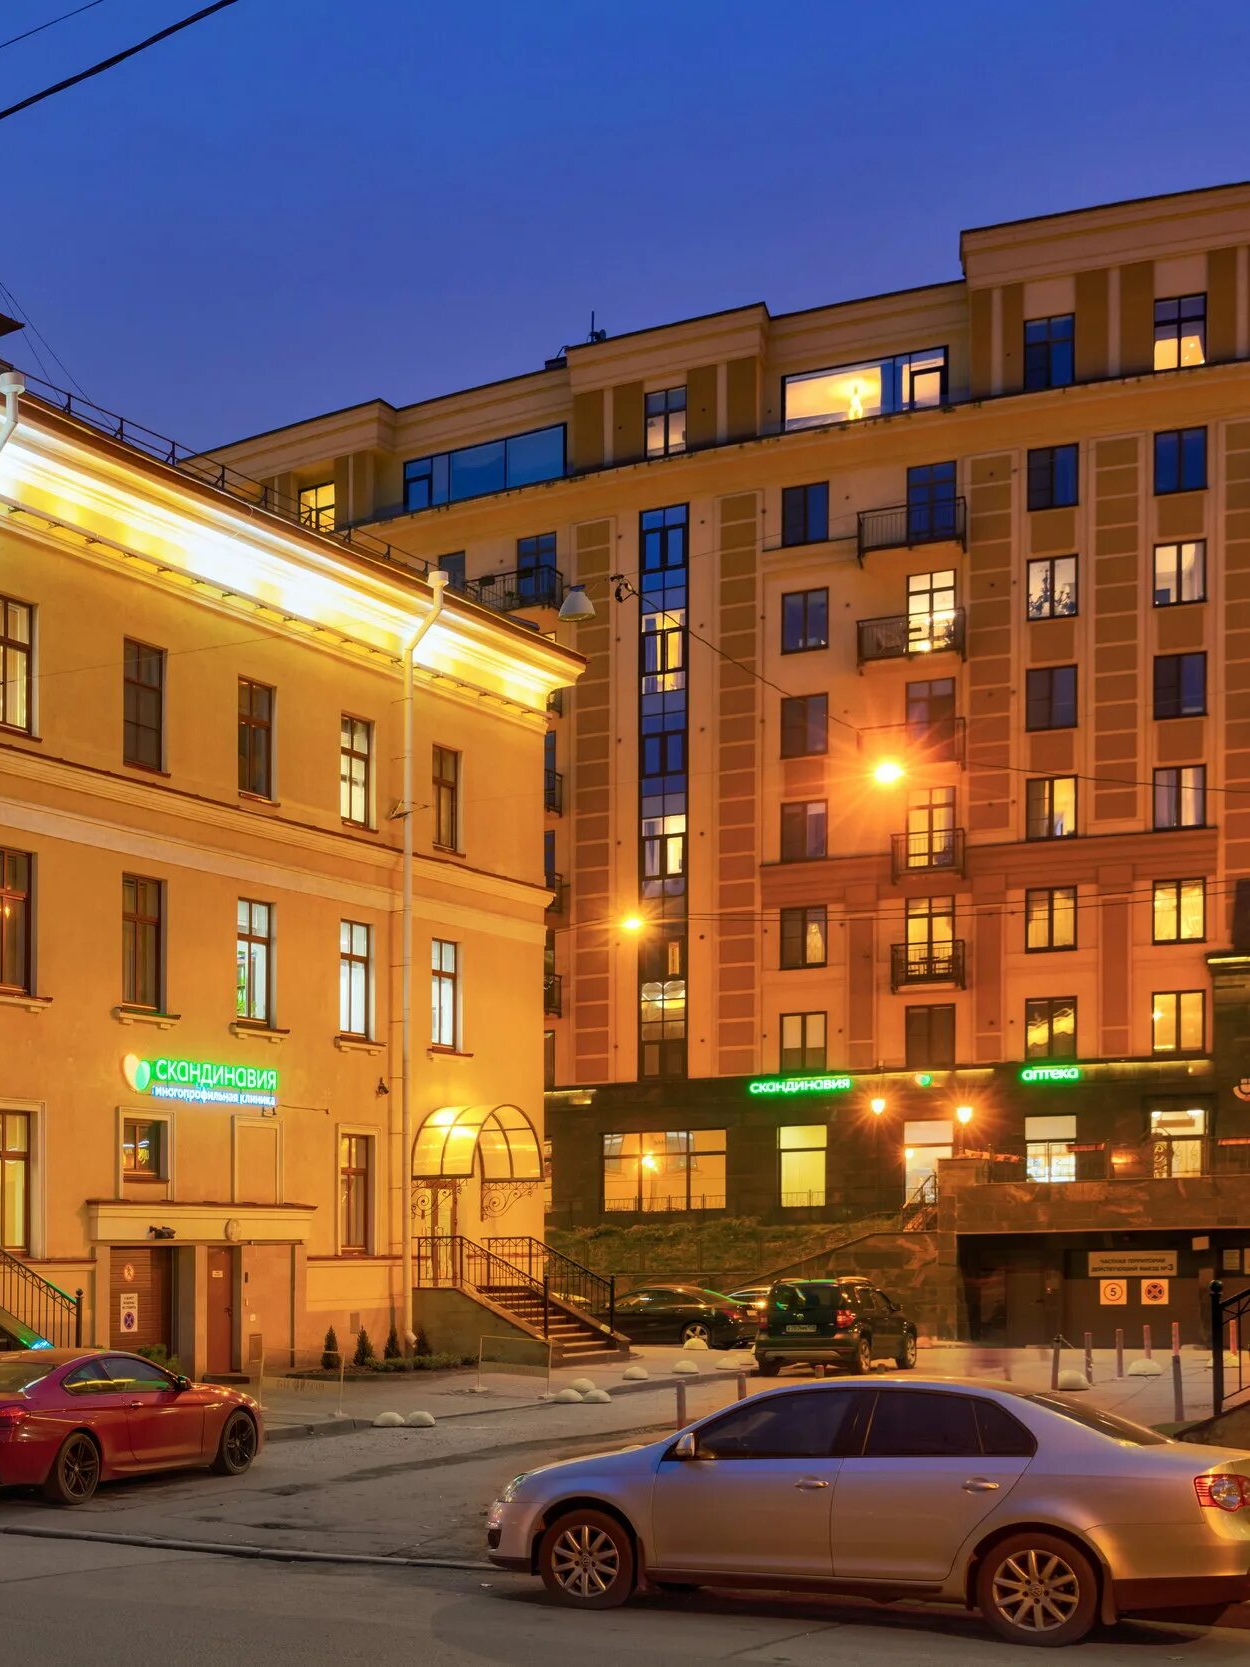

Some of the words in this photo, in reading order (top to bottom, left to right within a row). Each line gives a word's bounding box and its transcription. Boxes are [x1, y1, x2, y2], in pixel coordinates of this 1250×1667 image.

[1022, 1067, 1079, 1080] аптека
[154, 1086, 239, 1104] многопрофильная
[239, 1093, 276, 1106] клиника
[1110, 1287, 1117, 1297] 5
